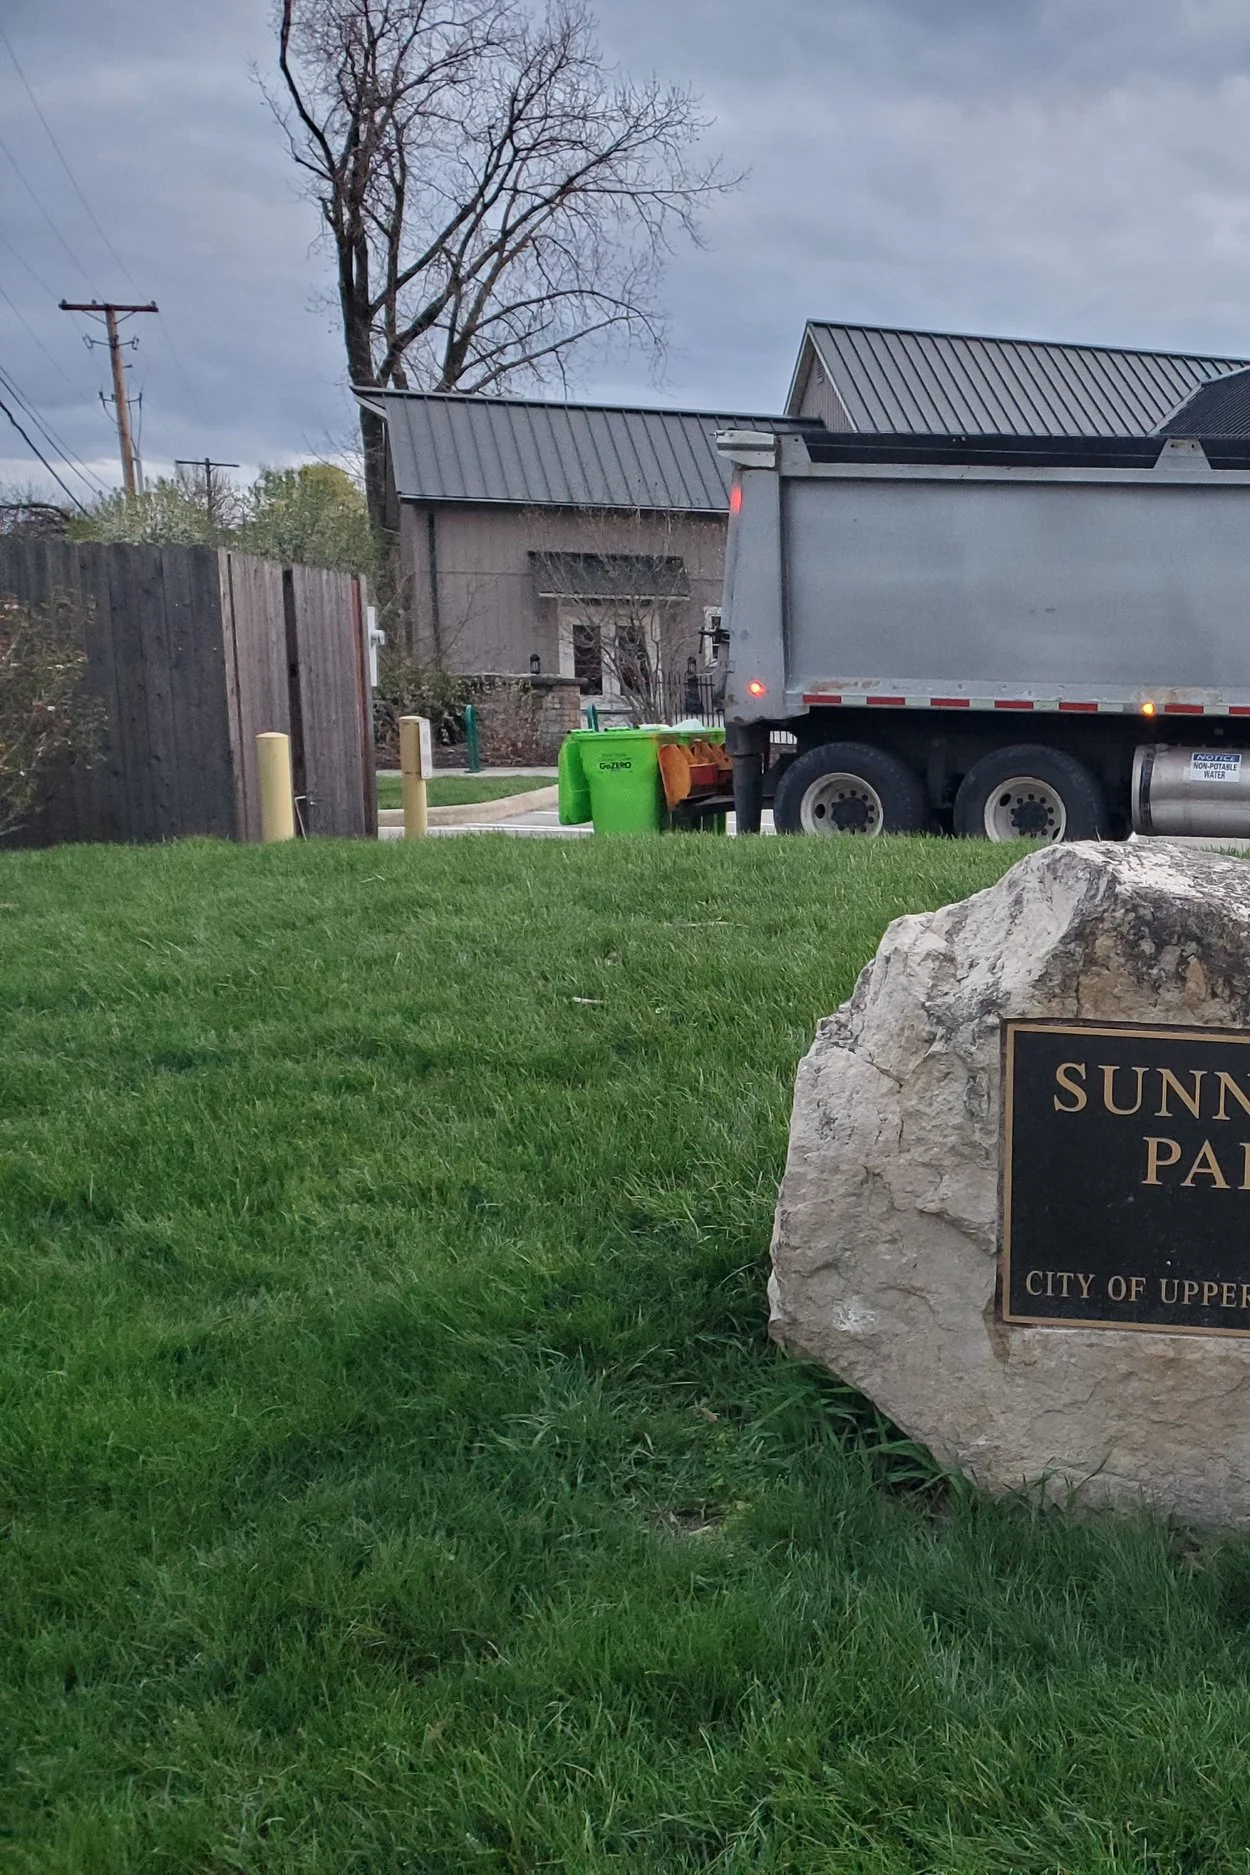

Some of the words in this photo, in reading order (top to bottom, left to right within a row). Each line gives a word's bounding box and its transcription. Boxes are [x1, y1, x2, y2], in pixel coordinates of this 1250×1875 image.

[1197, 754, 1235, 762] NOTICE
[599, 761, 632, 770] GoZERO
[1193, 762, 1237, 771] NON-POTABLE
[1203, 770, 1226, 780] WATER
[1025, 1270, 1095, 1300] CITY
[1107, 1275, 1147, 1303] OF
